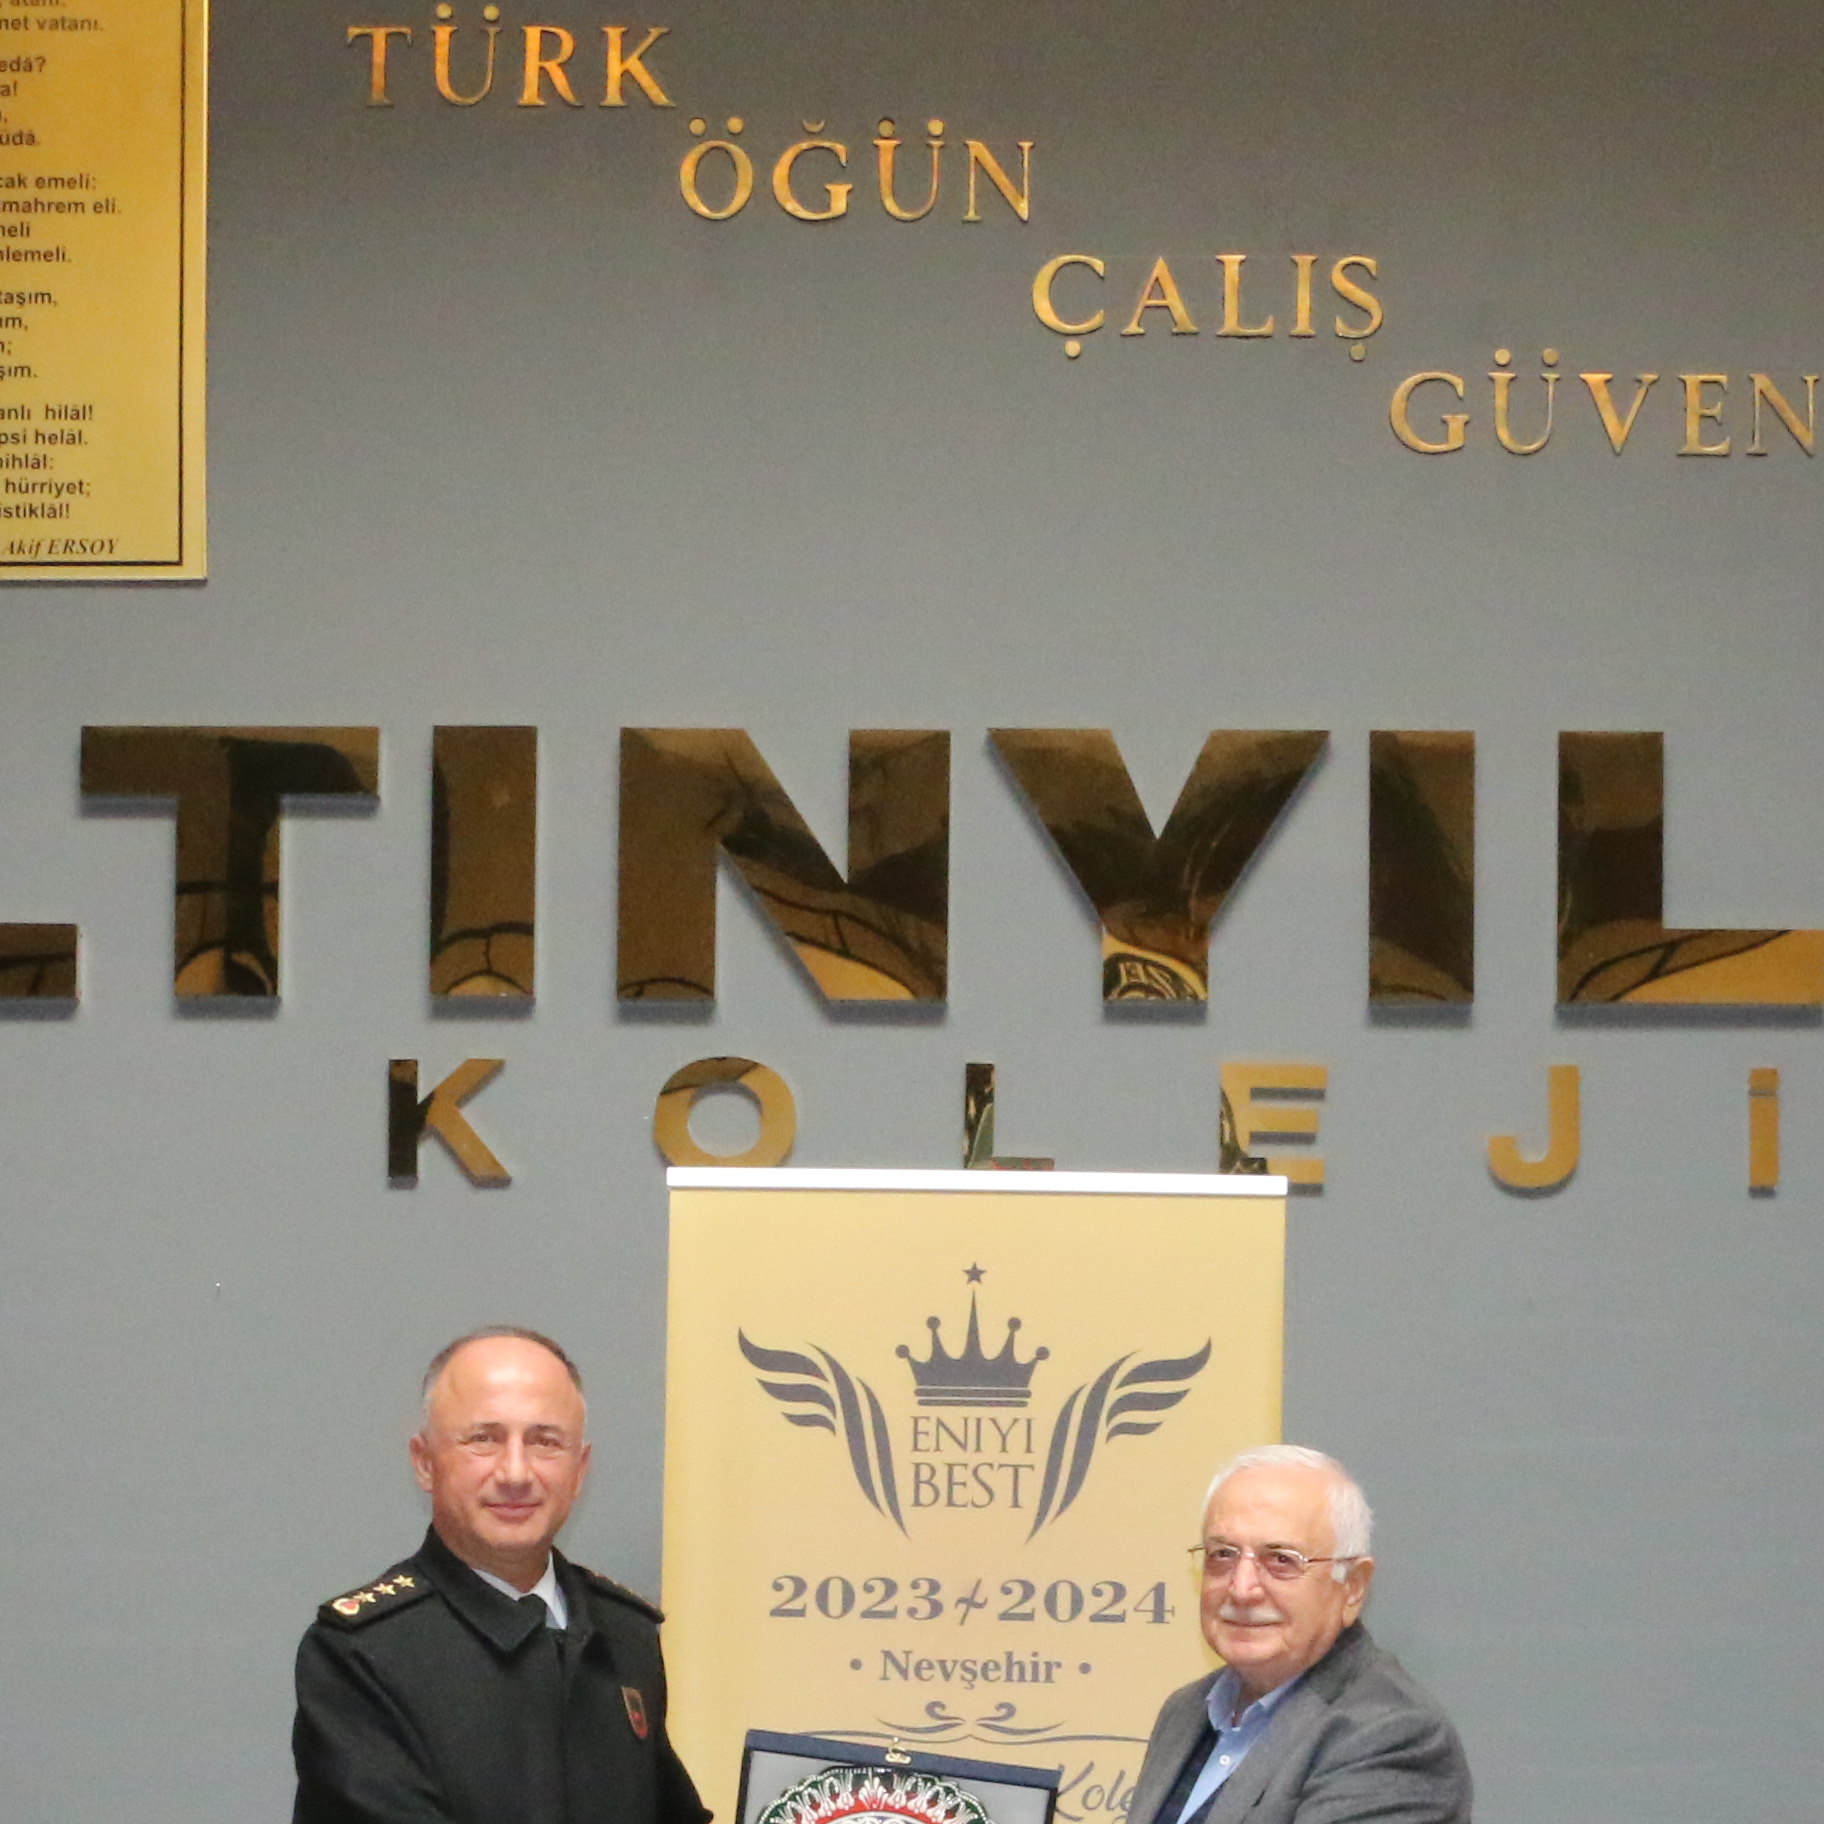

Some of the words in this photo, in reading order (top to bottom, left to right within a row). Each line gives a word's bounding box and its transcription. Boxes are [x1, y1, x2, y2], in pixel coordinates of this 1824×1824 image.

[347, 3, 674, 108] TÜRK
[678, 118, 1036, 224] ÖĞÜN
[1031, 253, 1385, 362] ÇALIŞ
[5, 538, 43, 560] Akif
[47, 538, 120, 556] ERSOY
[910, 1415, 1036, 1454] ENIYI
[910, 1461, 1036, 1509] BEST
[879, 1648, 1063, 1690] Nevşehir
